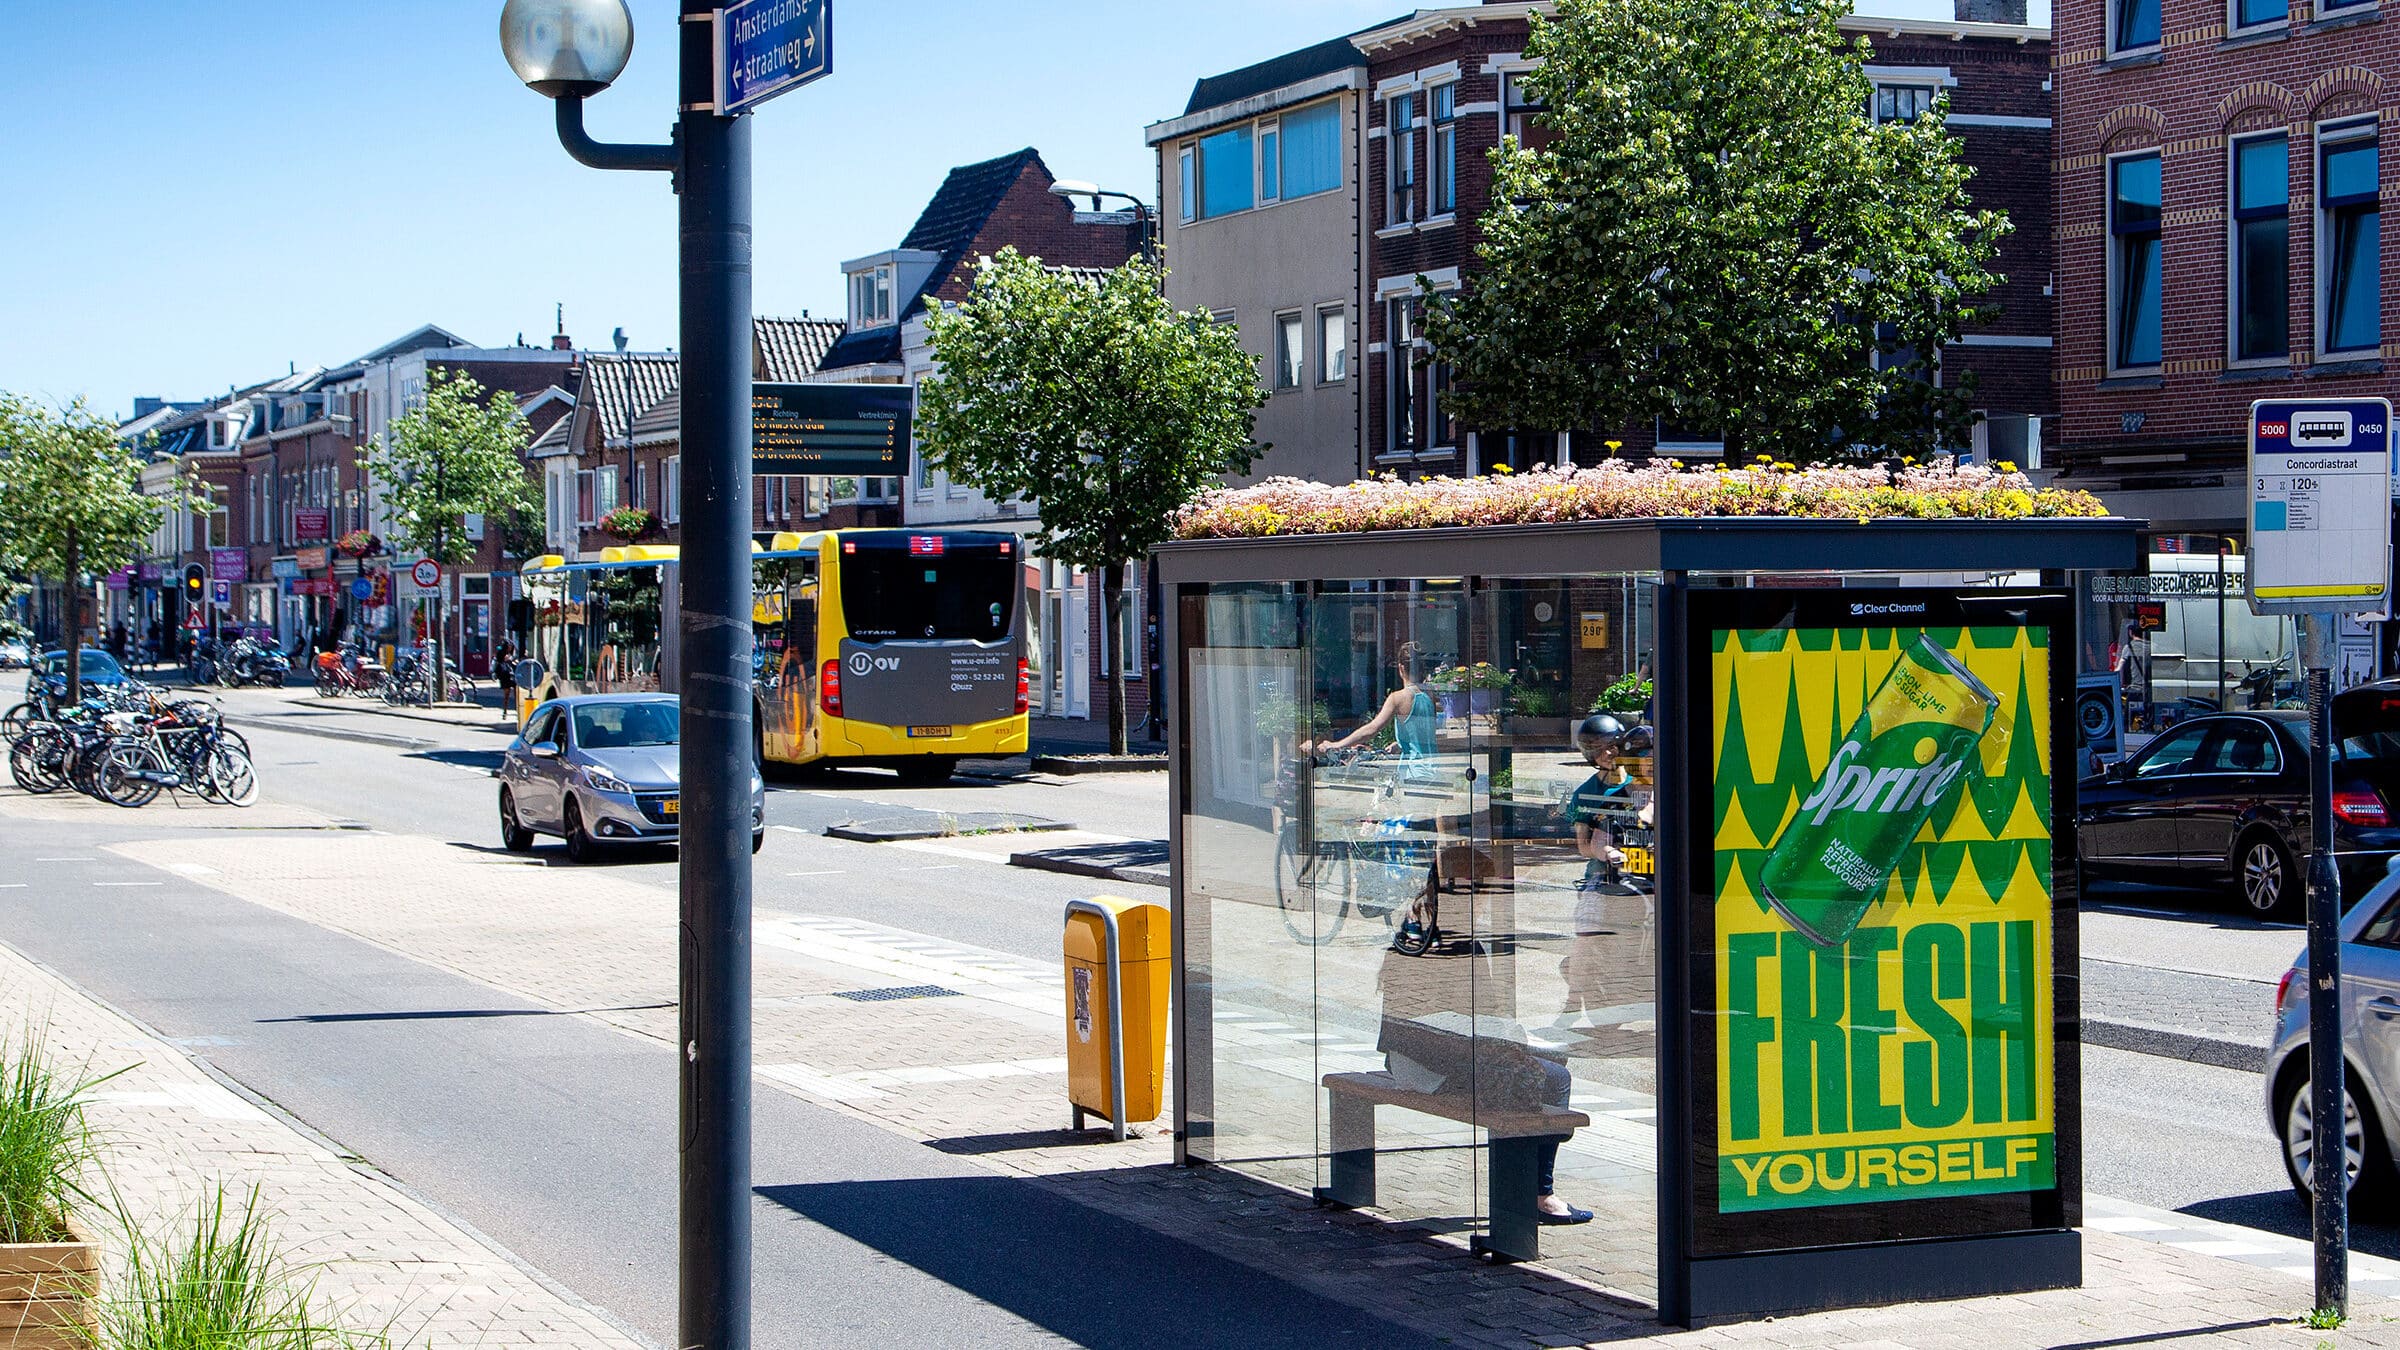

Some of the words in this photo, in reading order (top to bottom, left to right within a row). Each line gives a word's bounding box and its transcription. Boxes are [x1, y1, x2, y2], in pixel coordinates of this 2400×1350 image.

[745, 38, 801, 82] straatweg
[772, 410, 799, 419] Richting
[2261, 424, 2285, 436] 5000
[2358, 423, 2383, 435] 0450
[2286, 458, 2358, 470] Concordiastraat
[2257, 478, 2265, 491] 3
[2291, 477, 2312, 490] 120
[2091, 576, 2116, 593] ONZE
[2091, 594, 2107, 602] VOOR
[2107, 594, 2115, 602] AL
[2124, 594, 2138, 602] SLOT
[2138, 594, 2147, 602] EN
[1863, 603, 1888, 613] Clear
[1888, 602, 1925, 613] Channel
[951, 656, 1000, 665] www.u-ov.info
[951, 673, 968, 681] 0900
[951, 683, 974, 692] Qbuzz
[1900, 682, 1928, 711] SUGAR
[1801, 738, 1963, 826] Sprite
[1830, 837, 1882, 877] NATURALLY
[1820, 854, 1867, 891] FLAVOURS
[1825, 846, 1879, 887] REFRESHING
[1728, 920, 2037, 1142] FRESH
[1731, 1138, 2038, 1197] YOURSELF
